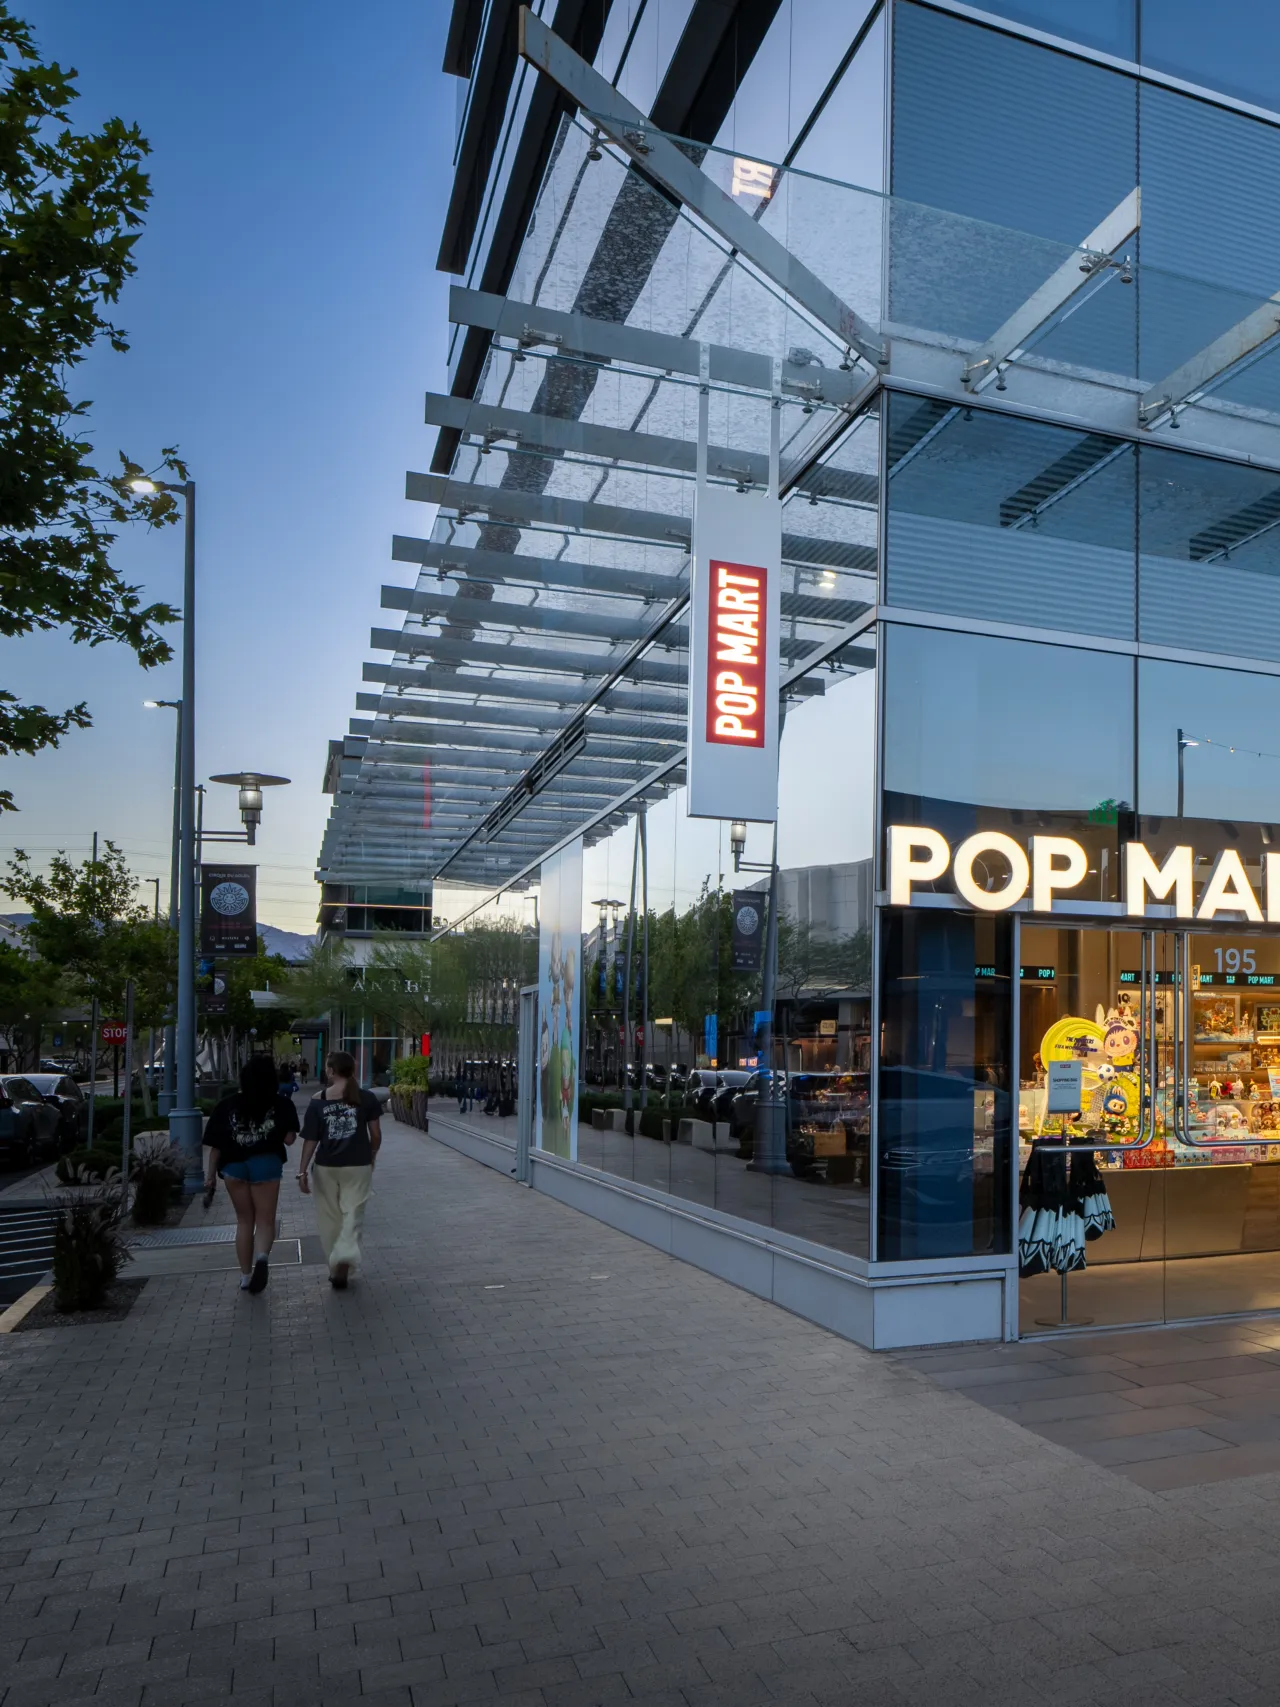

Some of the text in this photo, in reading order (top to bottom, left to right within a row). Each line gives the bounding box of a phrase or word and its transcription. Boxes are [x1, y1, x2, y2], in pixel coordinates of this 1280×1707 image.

[715, 567, 760, 739] POP MART
[887, 825, 1088, 911] POP
[1214, 948, 1256, 974] 195
[1248, 976, 1274, 985] POP MART
